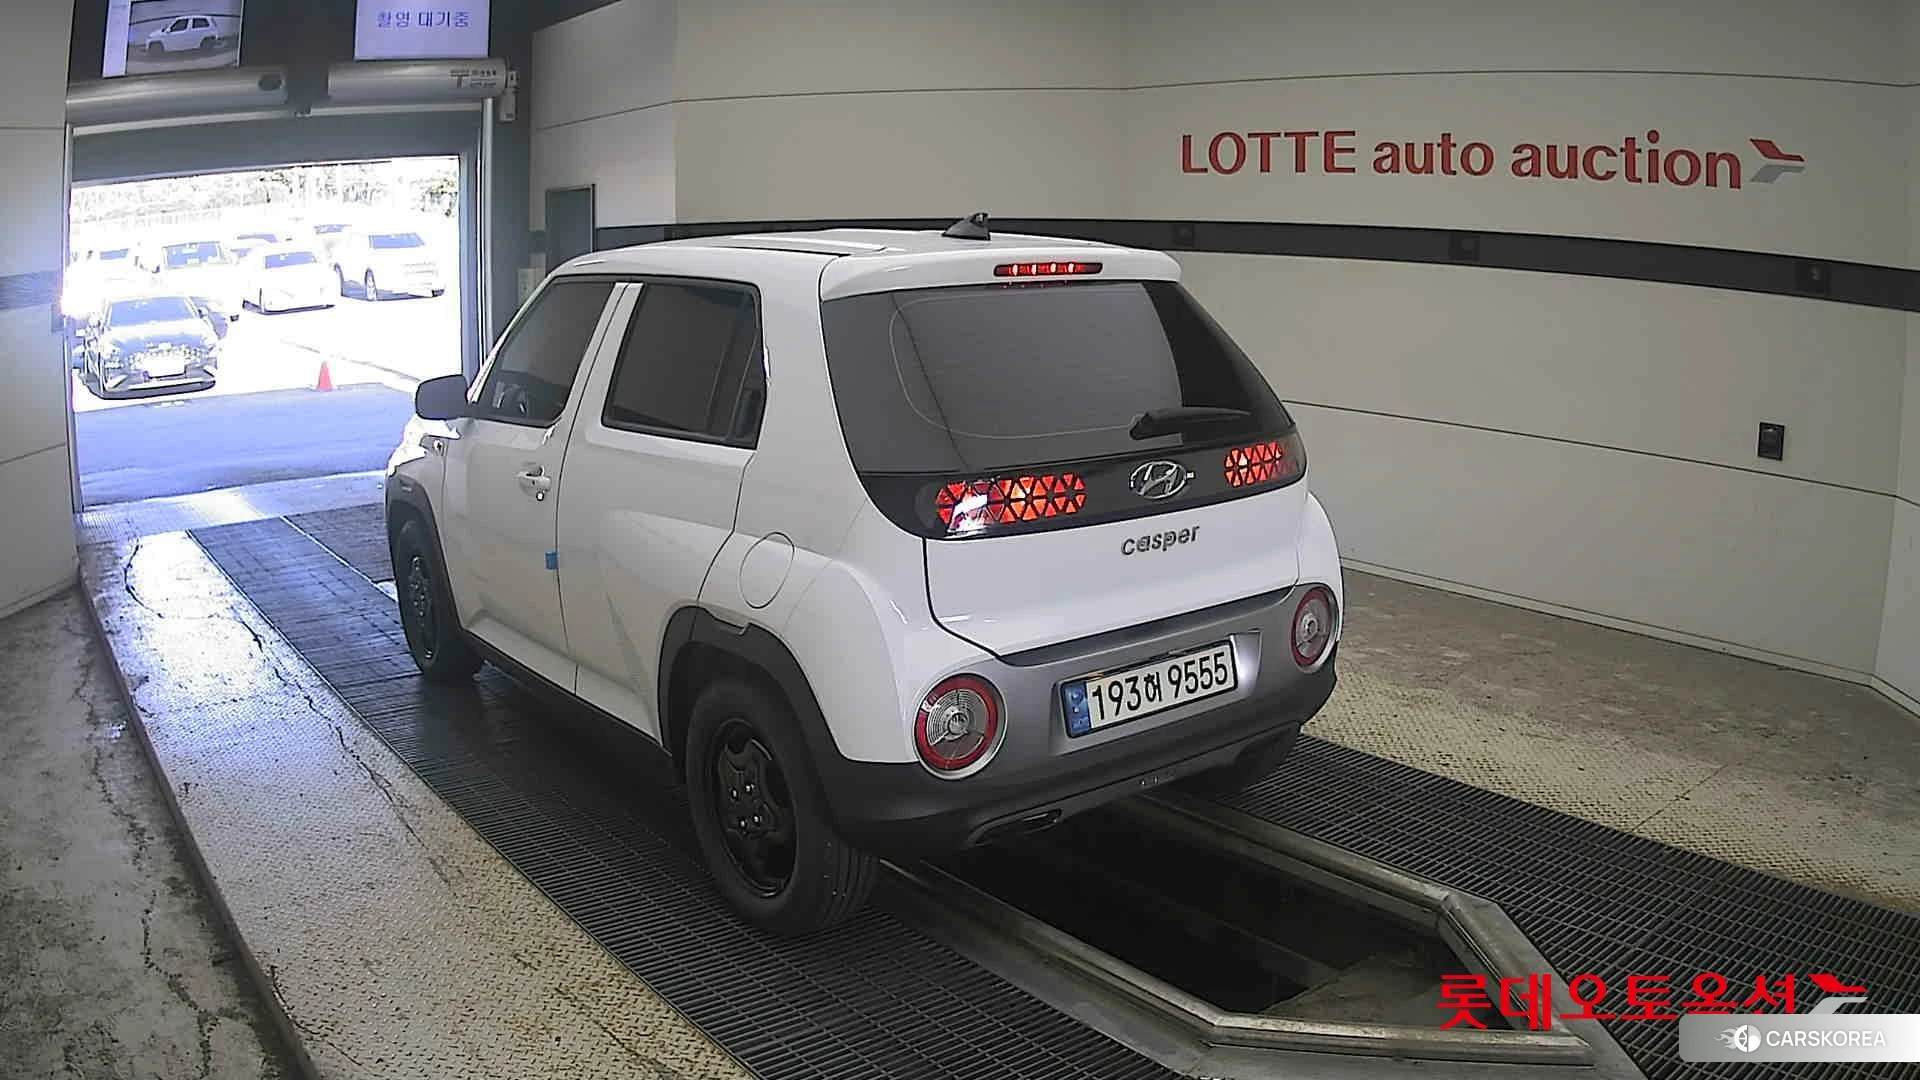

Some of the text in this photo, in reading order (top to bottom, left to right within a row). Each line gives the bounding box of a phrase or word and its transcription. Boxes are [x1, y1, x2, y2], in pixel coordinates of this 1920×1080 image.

[418, 10, 469, 28] 대기중
[1182, 130, 1742, 189] LOTTE auto auction
[1120, 524, 1201, 556] casper
[1091, 651, 1229, 721] 193허 9555
